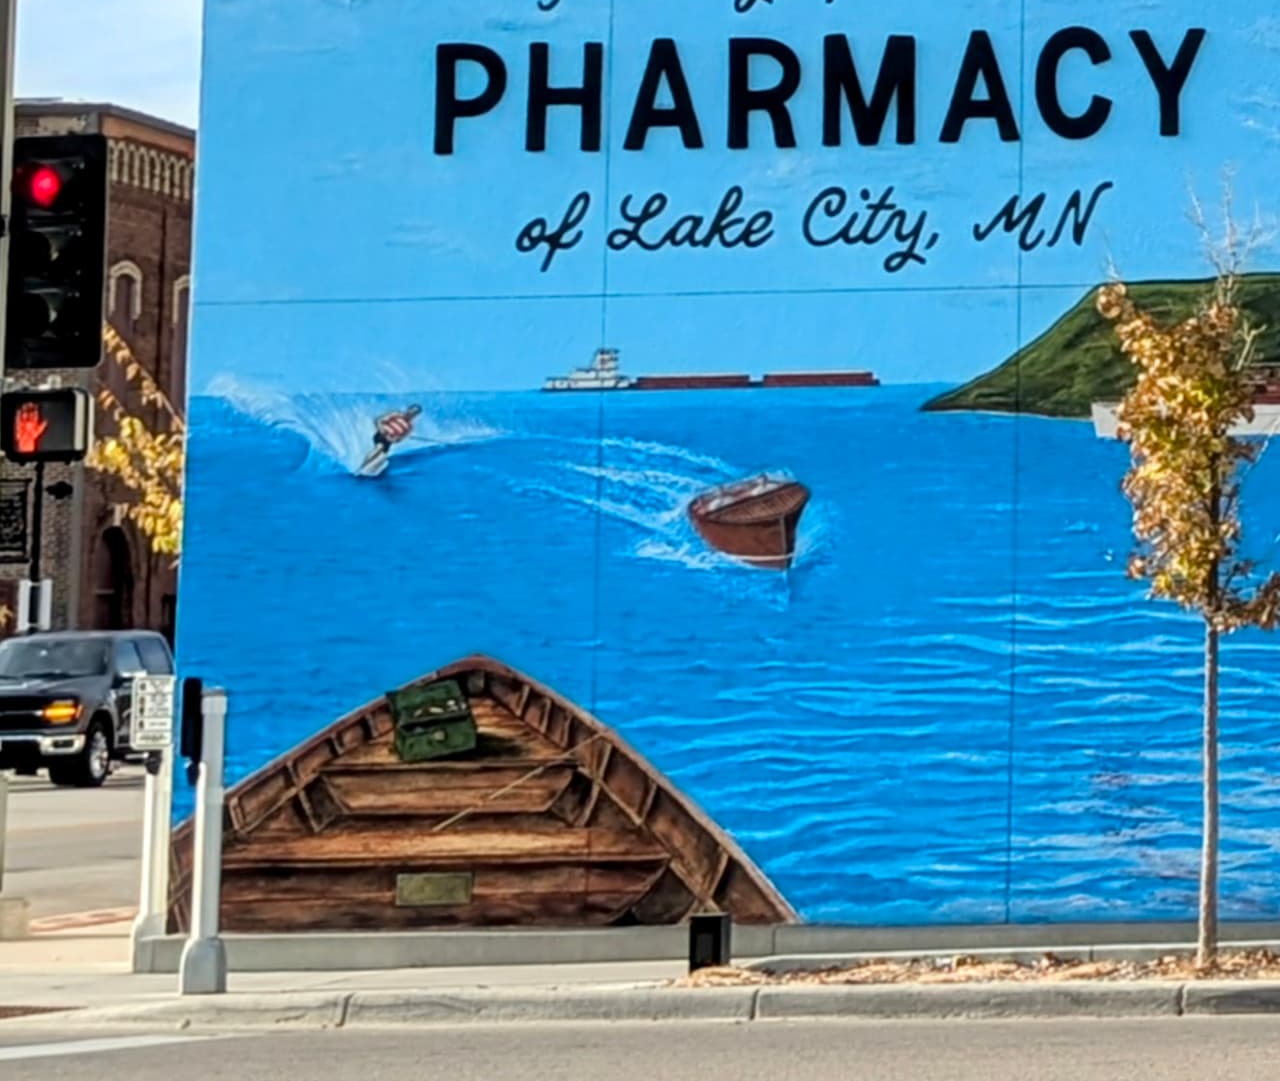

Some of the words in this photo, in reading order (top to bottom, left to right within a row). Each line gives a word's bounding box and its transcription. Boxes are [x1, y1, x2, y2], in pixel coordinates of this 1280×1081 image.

[433, 26, 1207, 156] PHARMACY
[515, 191, 591, 273] of
[606, 185, 774, 251] Lake
[802, 186, 939, 273] City,
[973, 181, 1114, 252] MN
